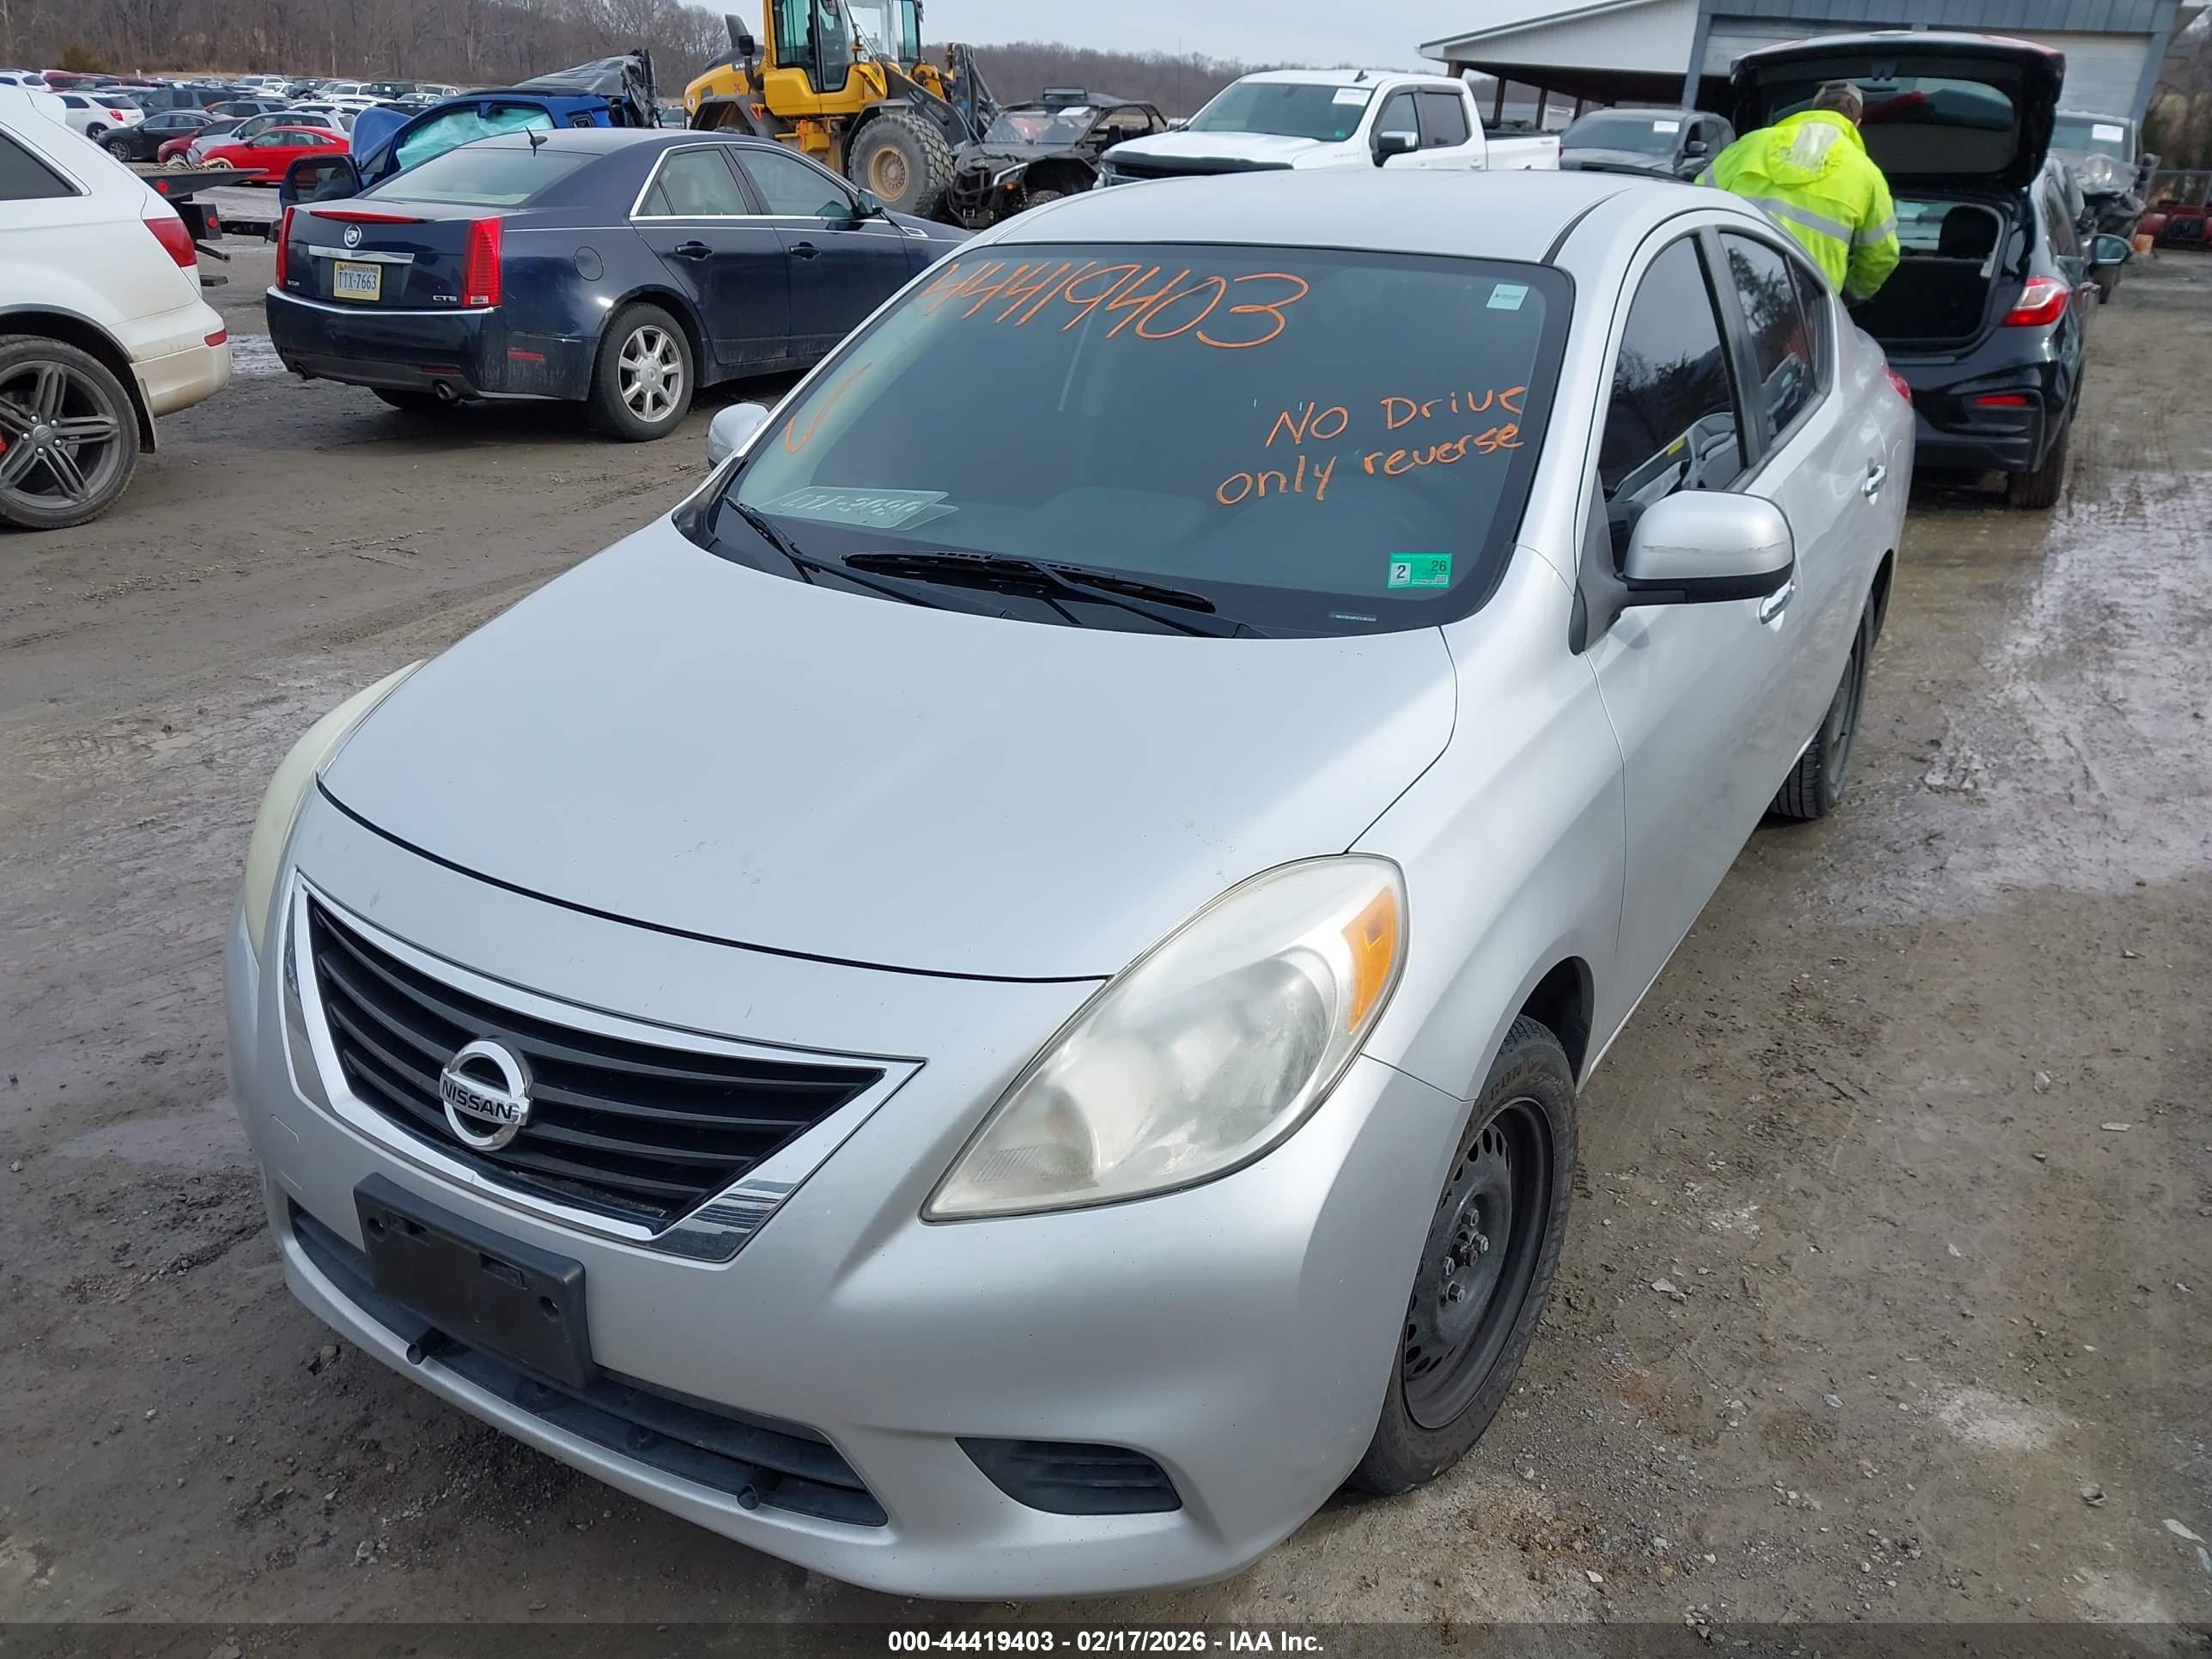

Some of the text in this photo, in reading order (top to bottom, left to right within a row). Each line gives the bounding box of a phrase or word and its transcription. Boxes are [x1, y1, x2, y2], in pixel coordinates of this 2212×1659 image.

[338, 270, 378, 290] TTX-7663
[921, 261, 1310, 349] 44419403
[1380, 386, 1526, 429] Drive
[1215, 422, 1524, 505] only reverse
[1396, 564, 1407, 579] 2
[1431, 560, 1448, 572] 26
[442, 1079, 513, 1119] NISSAN
